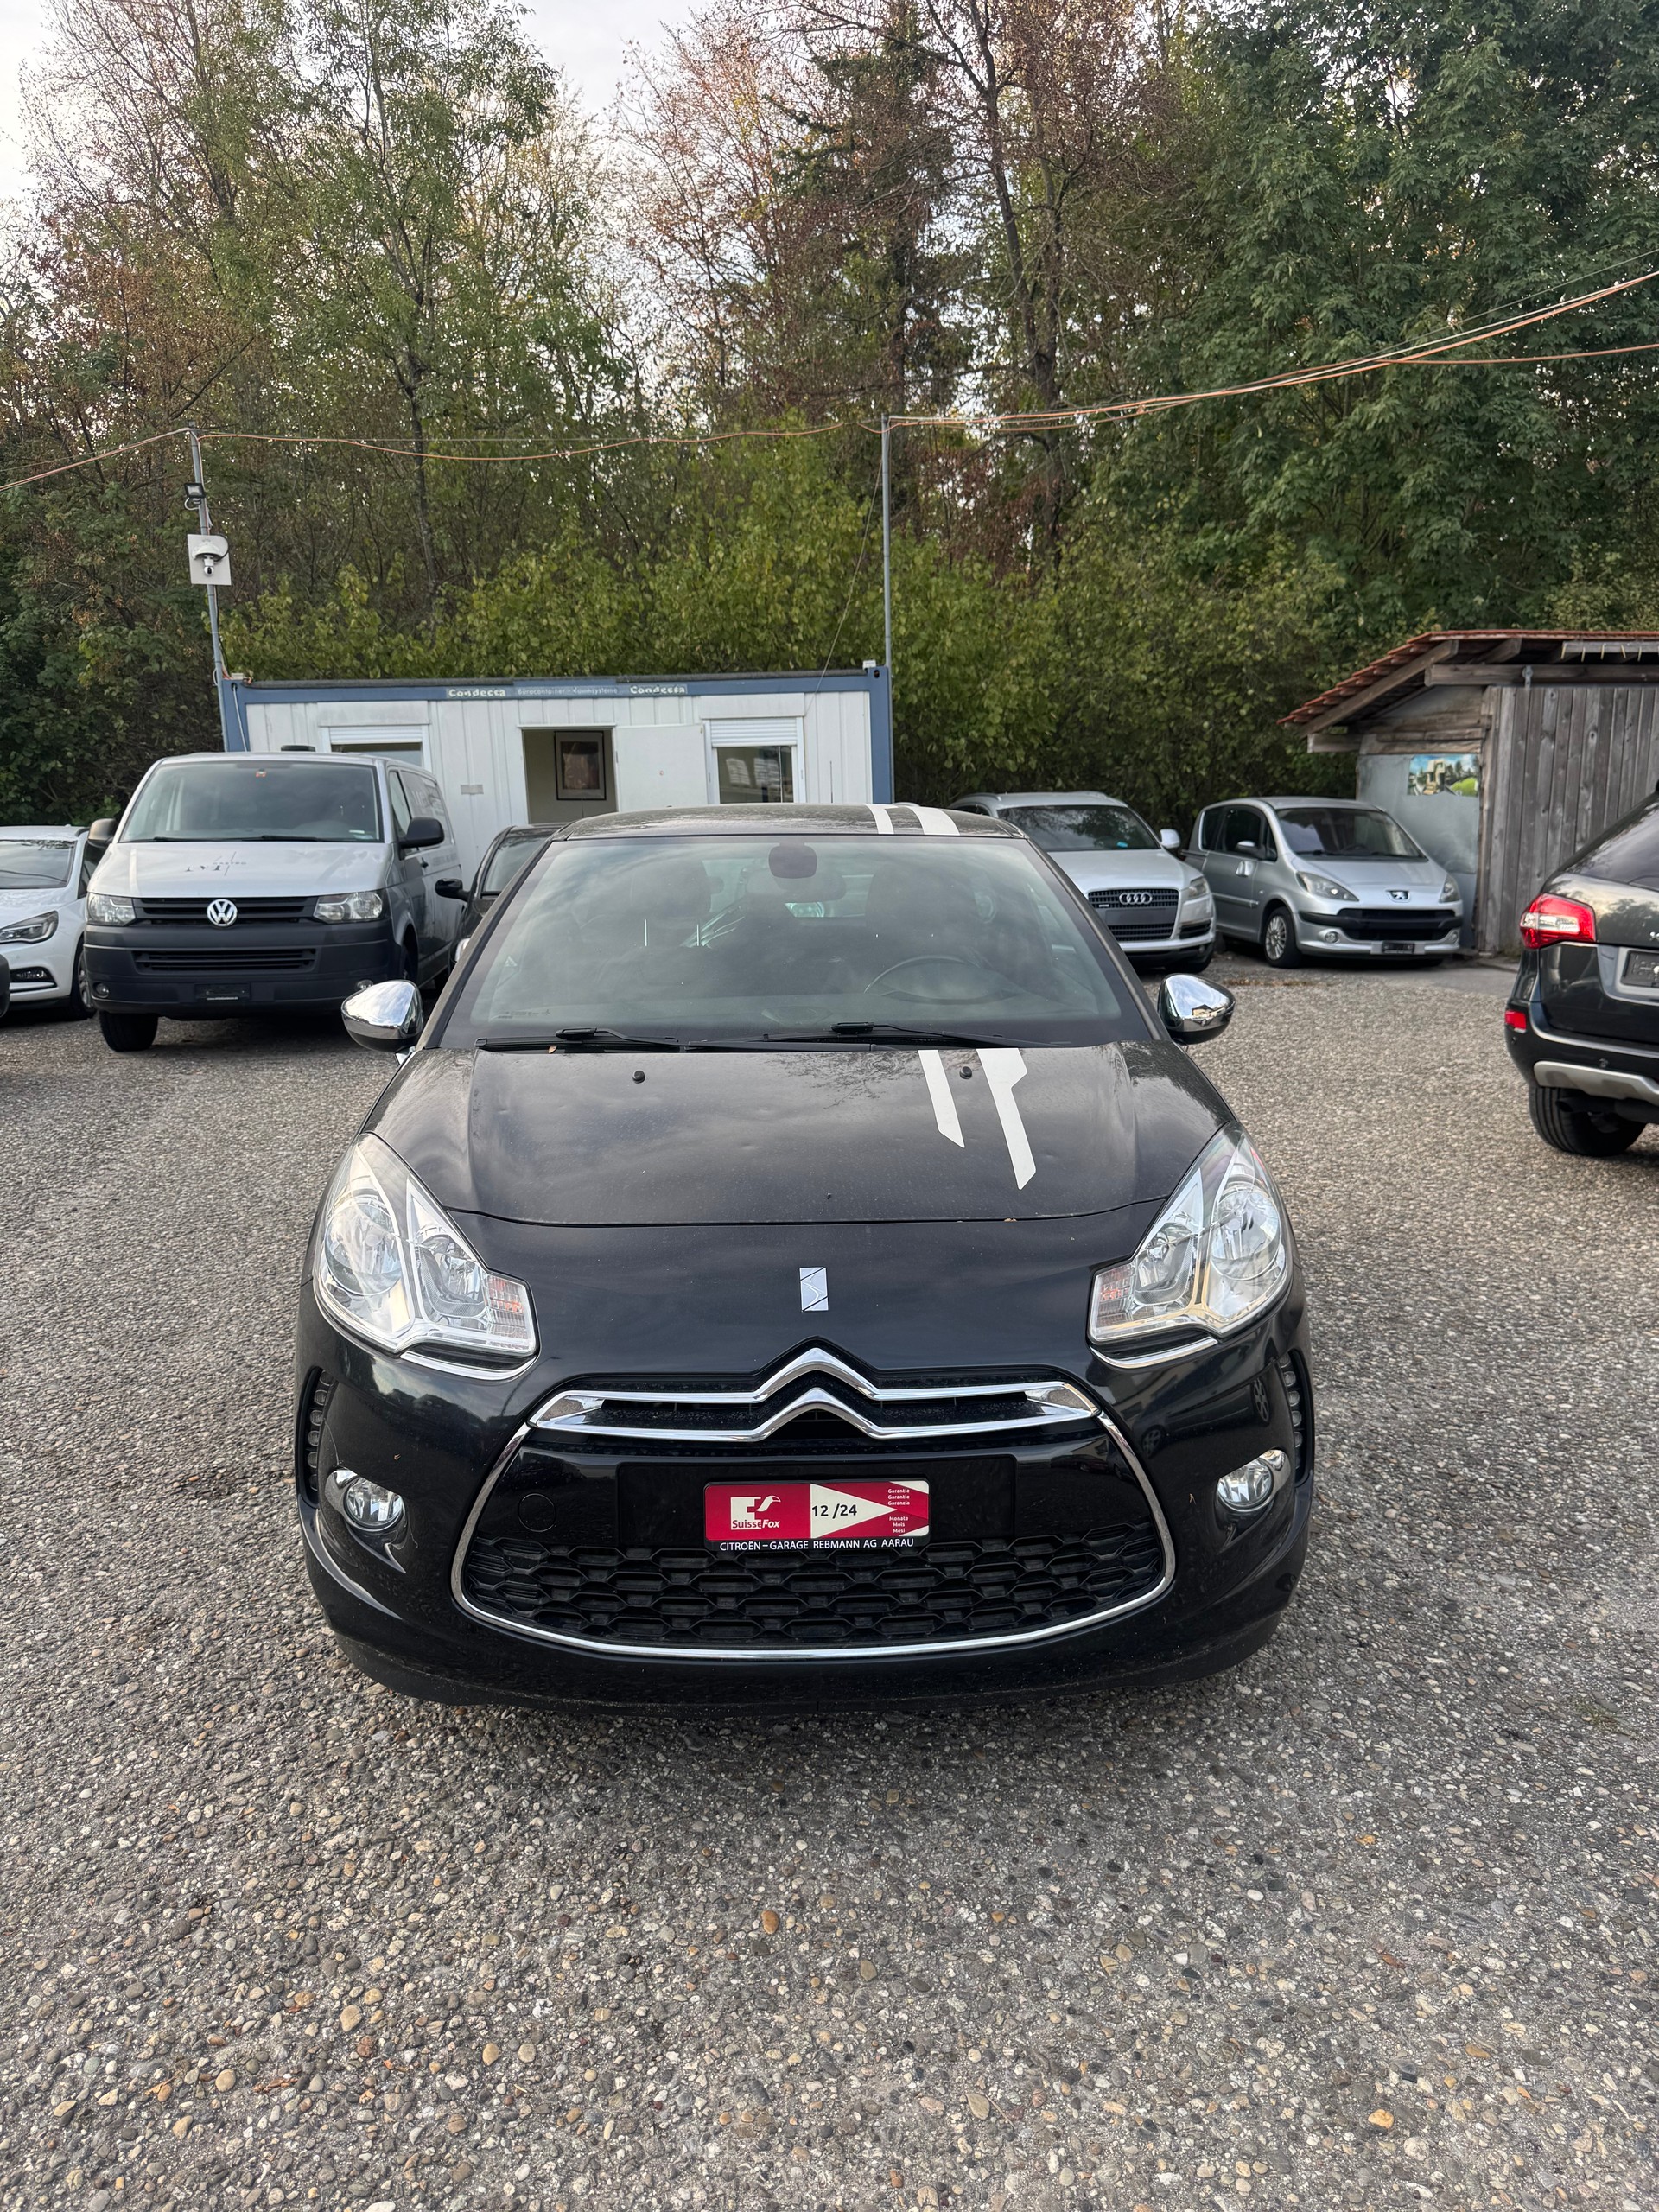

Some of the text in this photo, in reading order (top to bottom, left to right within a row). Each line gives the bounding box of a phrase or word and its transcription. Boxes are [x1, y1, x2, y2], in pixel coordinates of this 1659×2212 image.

[448, 688, 507, 697] Condecta
[629, 685, 685, 695] Condecta
[811, 1505, 829, 1517] 12
[813, 1540, 861, 1549] REBMANN
[863, 1539, 878, 1548] AG
[881, 1538, 914, 1548] AARAU
